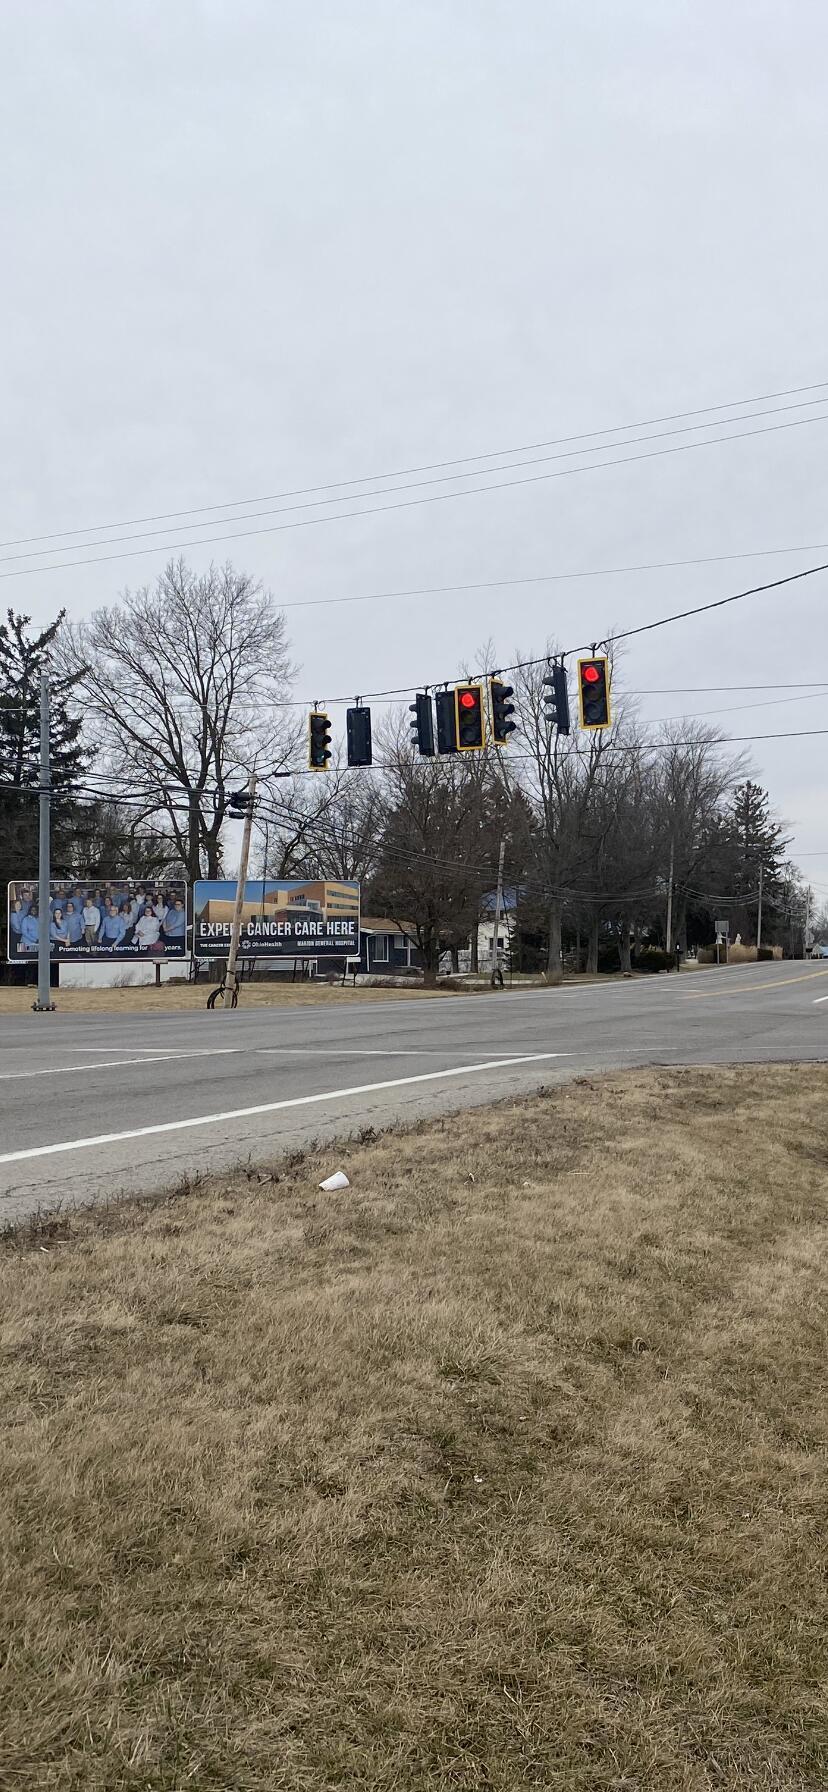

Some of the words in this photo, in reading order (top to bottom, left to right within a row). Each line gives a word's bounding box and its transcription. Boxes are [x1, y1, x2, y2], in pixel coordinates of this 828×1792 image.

[247, 922, 291, 935] CANCER
[295, 922, 323, 935] CARE
[327, 922, 355, 935] HERE
